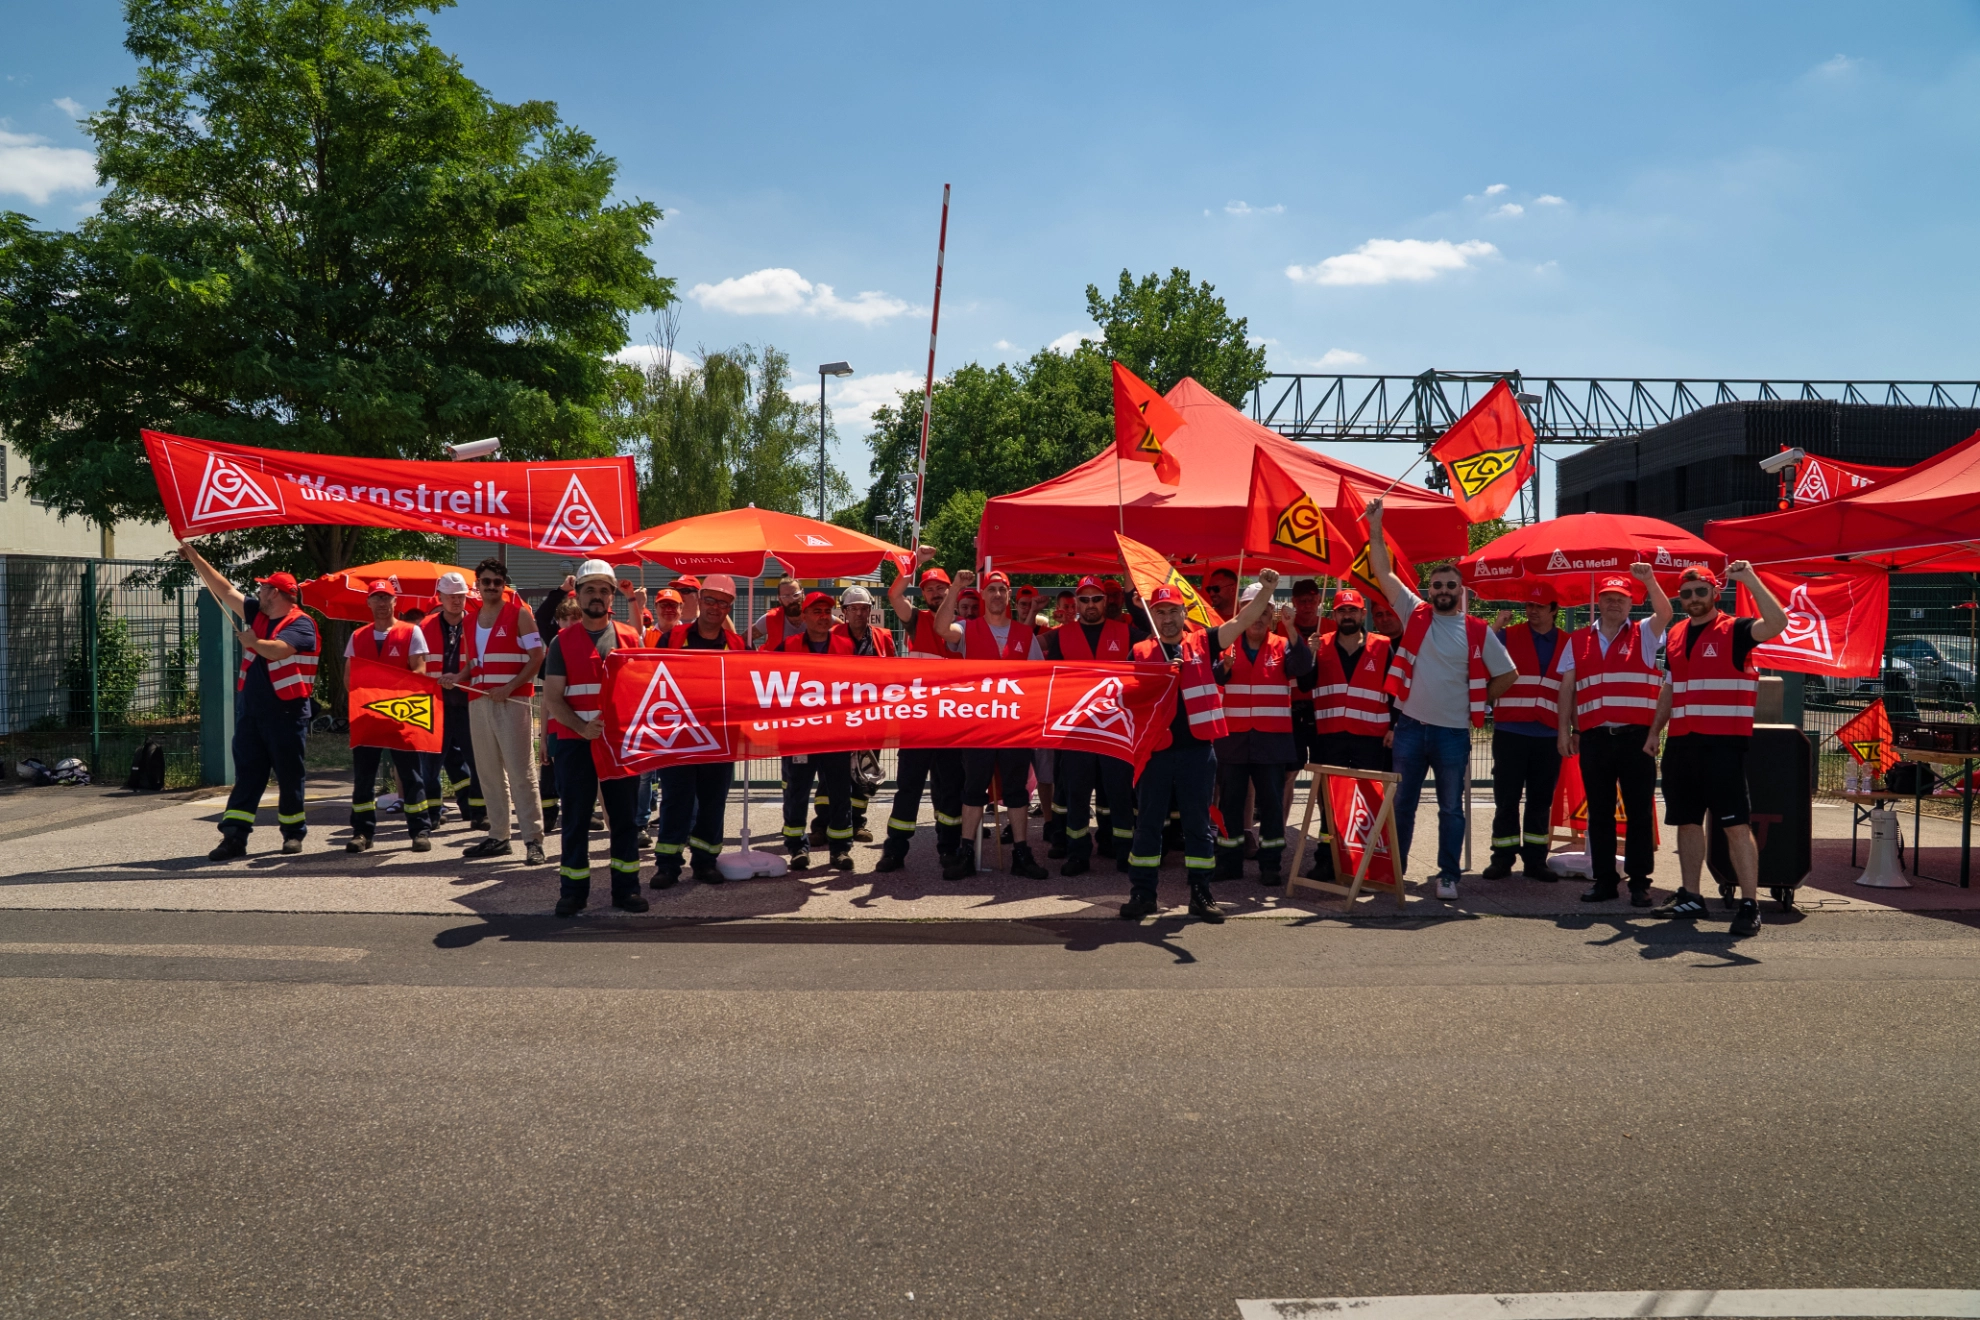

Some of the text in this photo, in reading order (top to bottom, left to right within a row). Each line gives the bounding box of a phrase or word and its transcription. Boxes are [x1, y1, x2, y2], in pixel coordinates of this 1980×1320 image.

[1573, 558, 1618, 568] IG Metall
[1673, 558, 1682, 567] IG
[845, 703, 928, 728] gutes
[938, 698, 1022, 720] Recht
